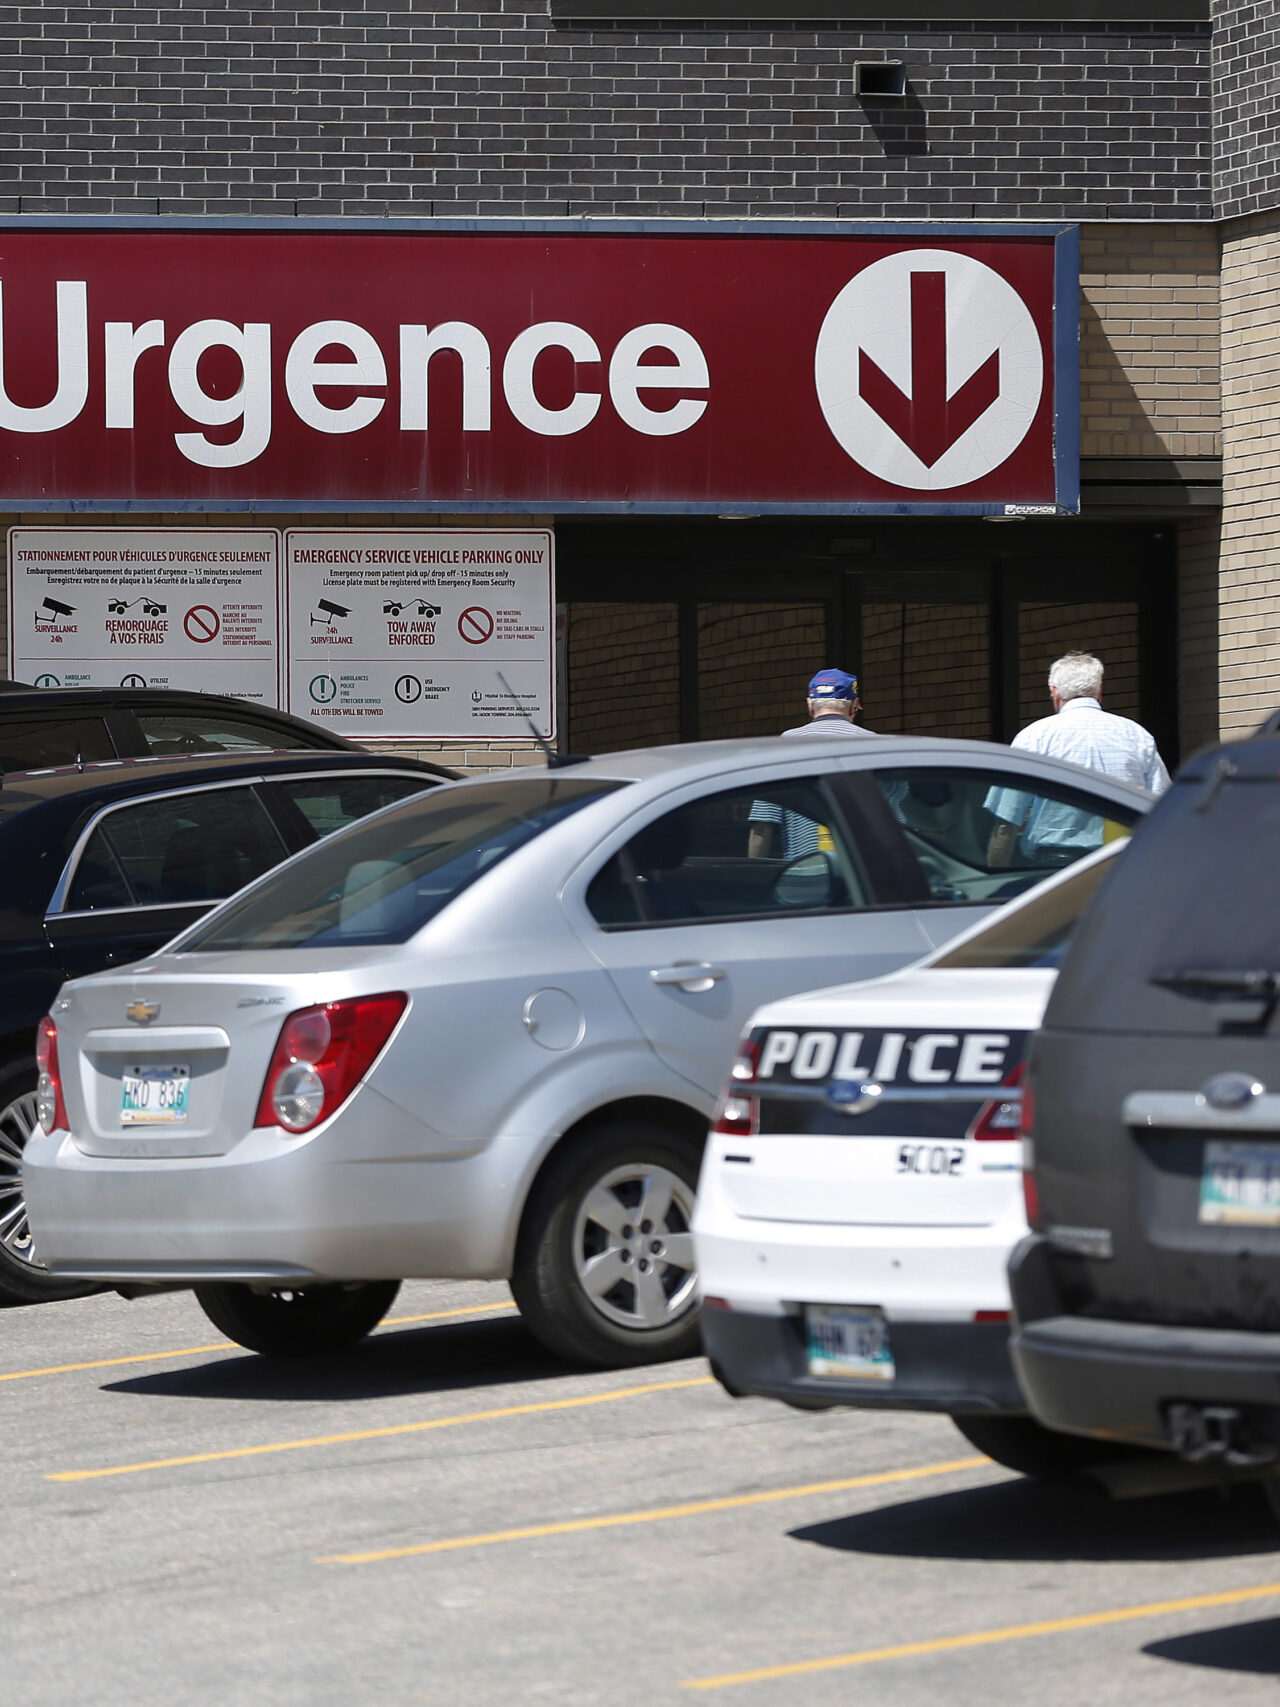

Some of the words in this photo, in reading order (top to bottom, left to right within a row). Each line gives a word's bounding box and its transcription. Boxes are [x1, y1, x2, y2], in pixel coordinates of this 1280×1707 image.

[18, 551, 90, 562] STATIONNEMENT
[93, 551, 117, 562] POUR
[120, 549, 167, 562] VÉHICULES
[170, 551, 217, 562] D'URGENCE
[220, 551, 271, 562] SEULEMENT
[294, 550, 362, 563] EMERGENCY
[366, 550, 410, 563] SERVICE
[413, 551, 459, 563] VEHICLE
[463, 551, 512, 563] PARKING
[515, 551, 543, 564] ONLY
[27, 567, 122, 576] Embarquement/débarquement
[133, 568, 156, 576] patient
[158, 568, 187, 577] d'urgence
[204, 568, 228, 576] minutes
[330, 569, 363, 578] Emergency
[382, 570, 405, 578] patient
[406, 569, 418, 578] pick
[432, 570, 445, 578] drop
[495, 570, 508, 579] only
[47, 577, 82, 585] Enregistrez
[119, 577, 140, 585] plaque
[212, 577, 242, 586] d'urgence
[323, 578, 345, 586] License
[347, 578, 362, 587] plate
[381, 578, 388, 586] be
[390, 579, 421, 587] registered
[438, 579, 470, 588] Emergency
[491, 579, 515, 588] Security
[106, 620, 168, 632] REMORQUAGE
[388, 622, 407, 632] TOW
[410, 622, 436, 632] AWAY
[110, 631, 116, 644] À
[119, 633, 136, 644] VOS
[139, 633, 164, 644] FRAIS
[389, 634, 435, 645] ENFORCED
[757, 1031, 1010, 1082] POLICE
[160, 1080, 184, 1107] 836
